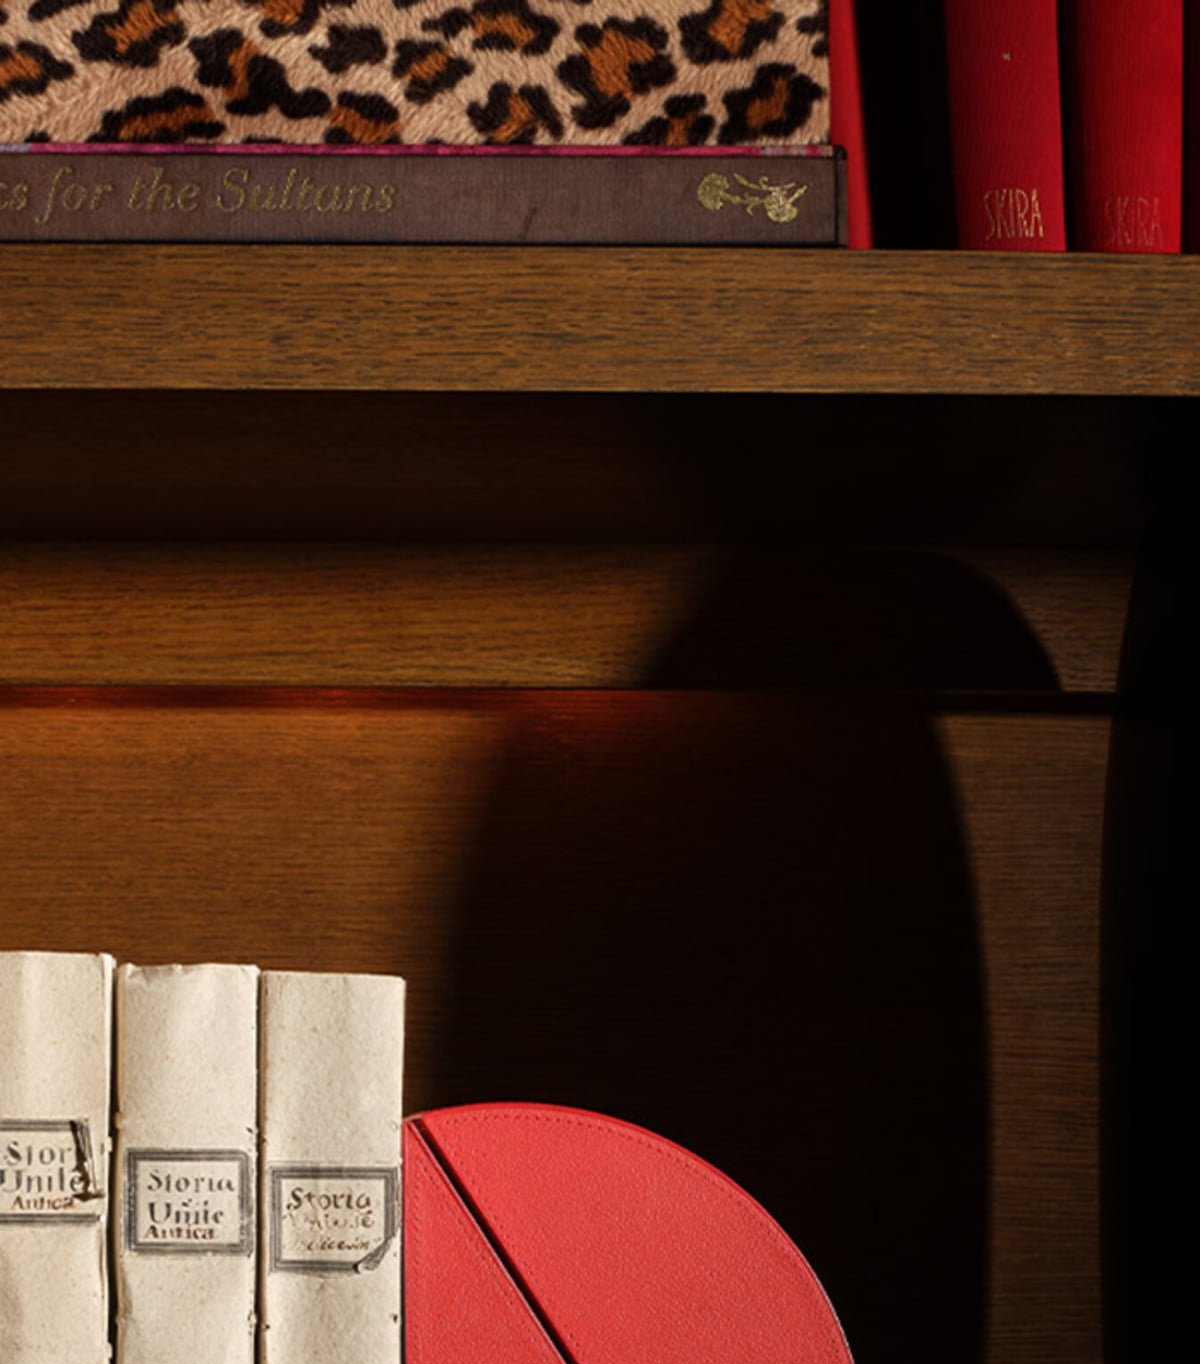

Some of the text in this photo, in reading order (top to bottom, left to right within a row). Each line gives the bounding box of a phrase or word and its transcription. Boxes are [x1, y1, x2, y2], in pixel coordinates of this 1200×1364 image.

[34, 165, 117, 225] for
[127, 165, 201, 214] the
[214, 166, 397, 214] Sultans
[983, 187, 1044, 241] SKIRA
[1105, 196, 1164, 248] SKIRA
[146, 1169, 236, 1194] Storia
[286, 1186, 372, 1211] Storia
